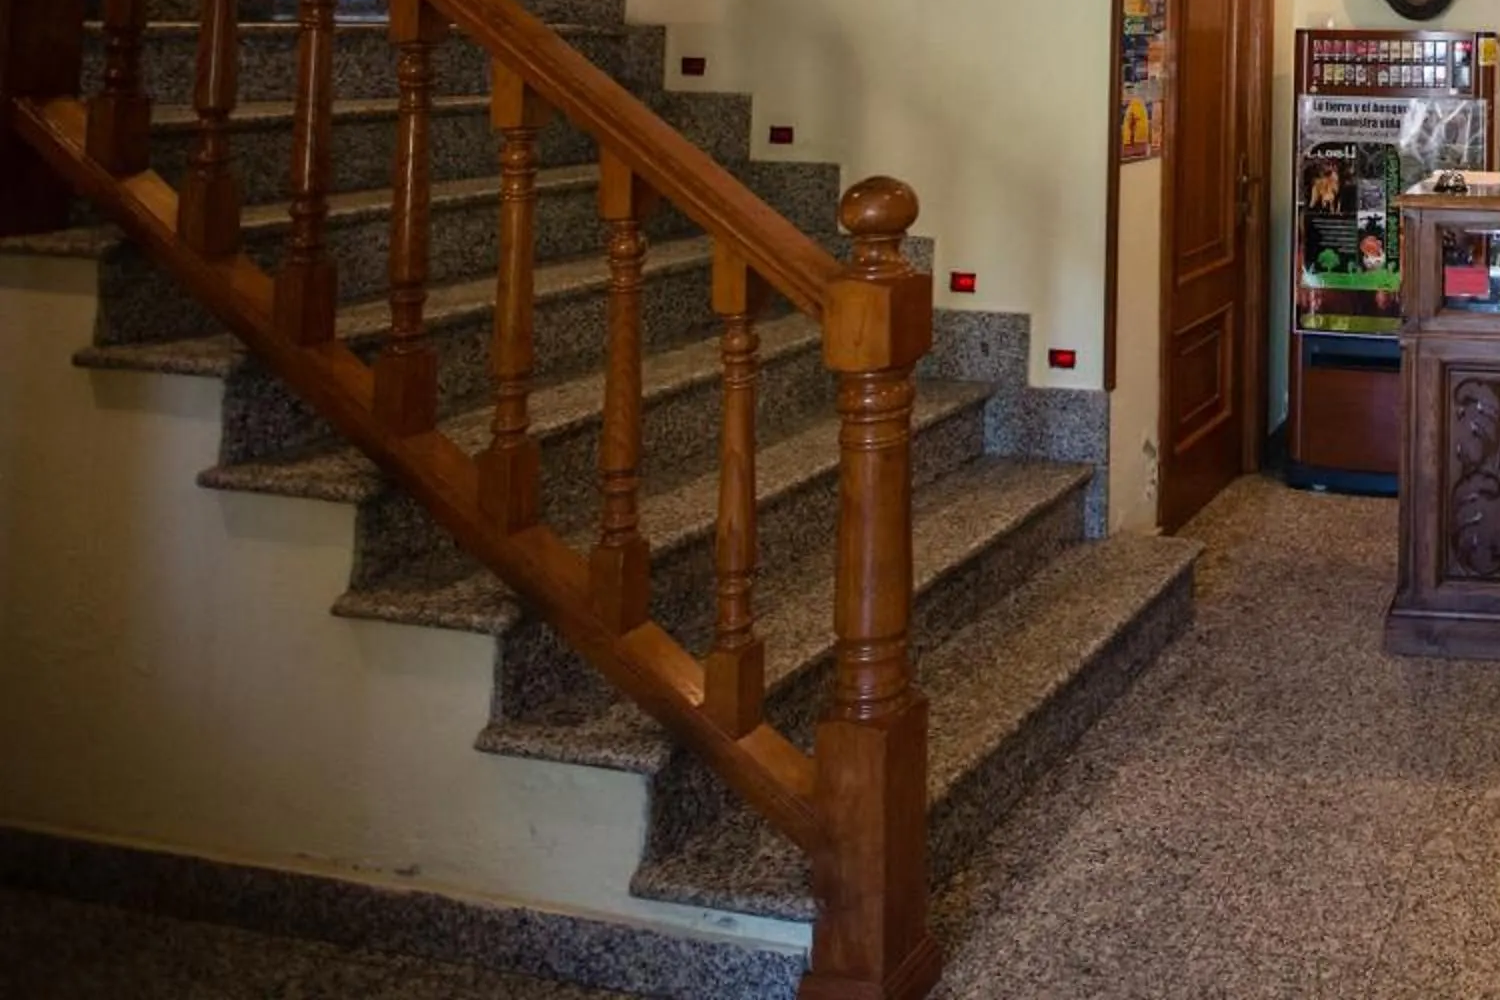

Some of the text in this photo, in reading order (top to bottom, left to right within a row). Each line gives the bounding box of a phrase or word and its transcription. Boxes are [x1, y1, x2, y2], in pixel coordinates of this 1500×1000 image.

[1325, 100, 1352, 113] tierra
[1354, 103, 1360, 114] y
[1380, 117, 1401, 129] vida
